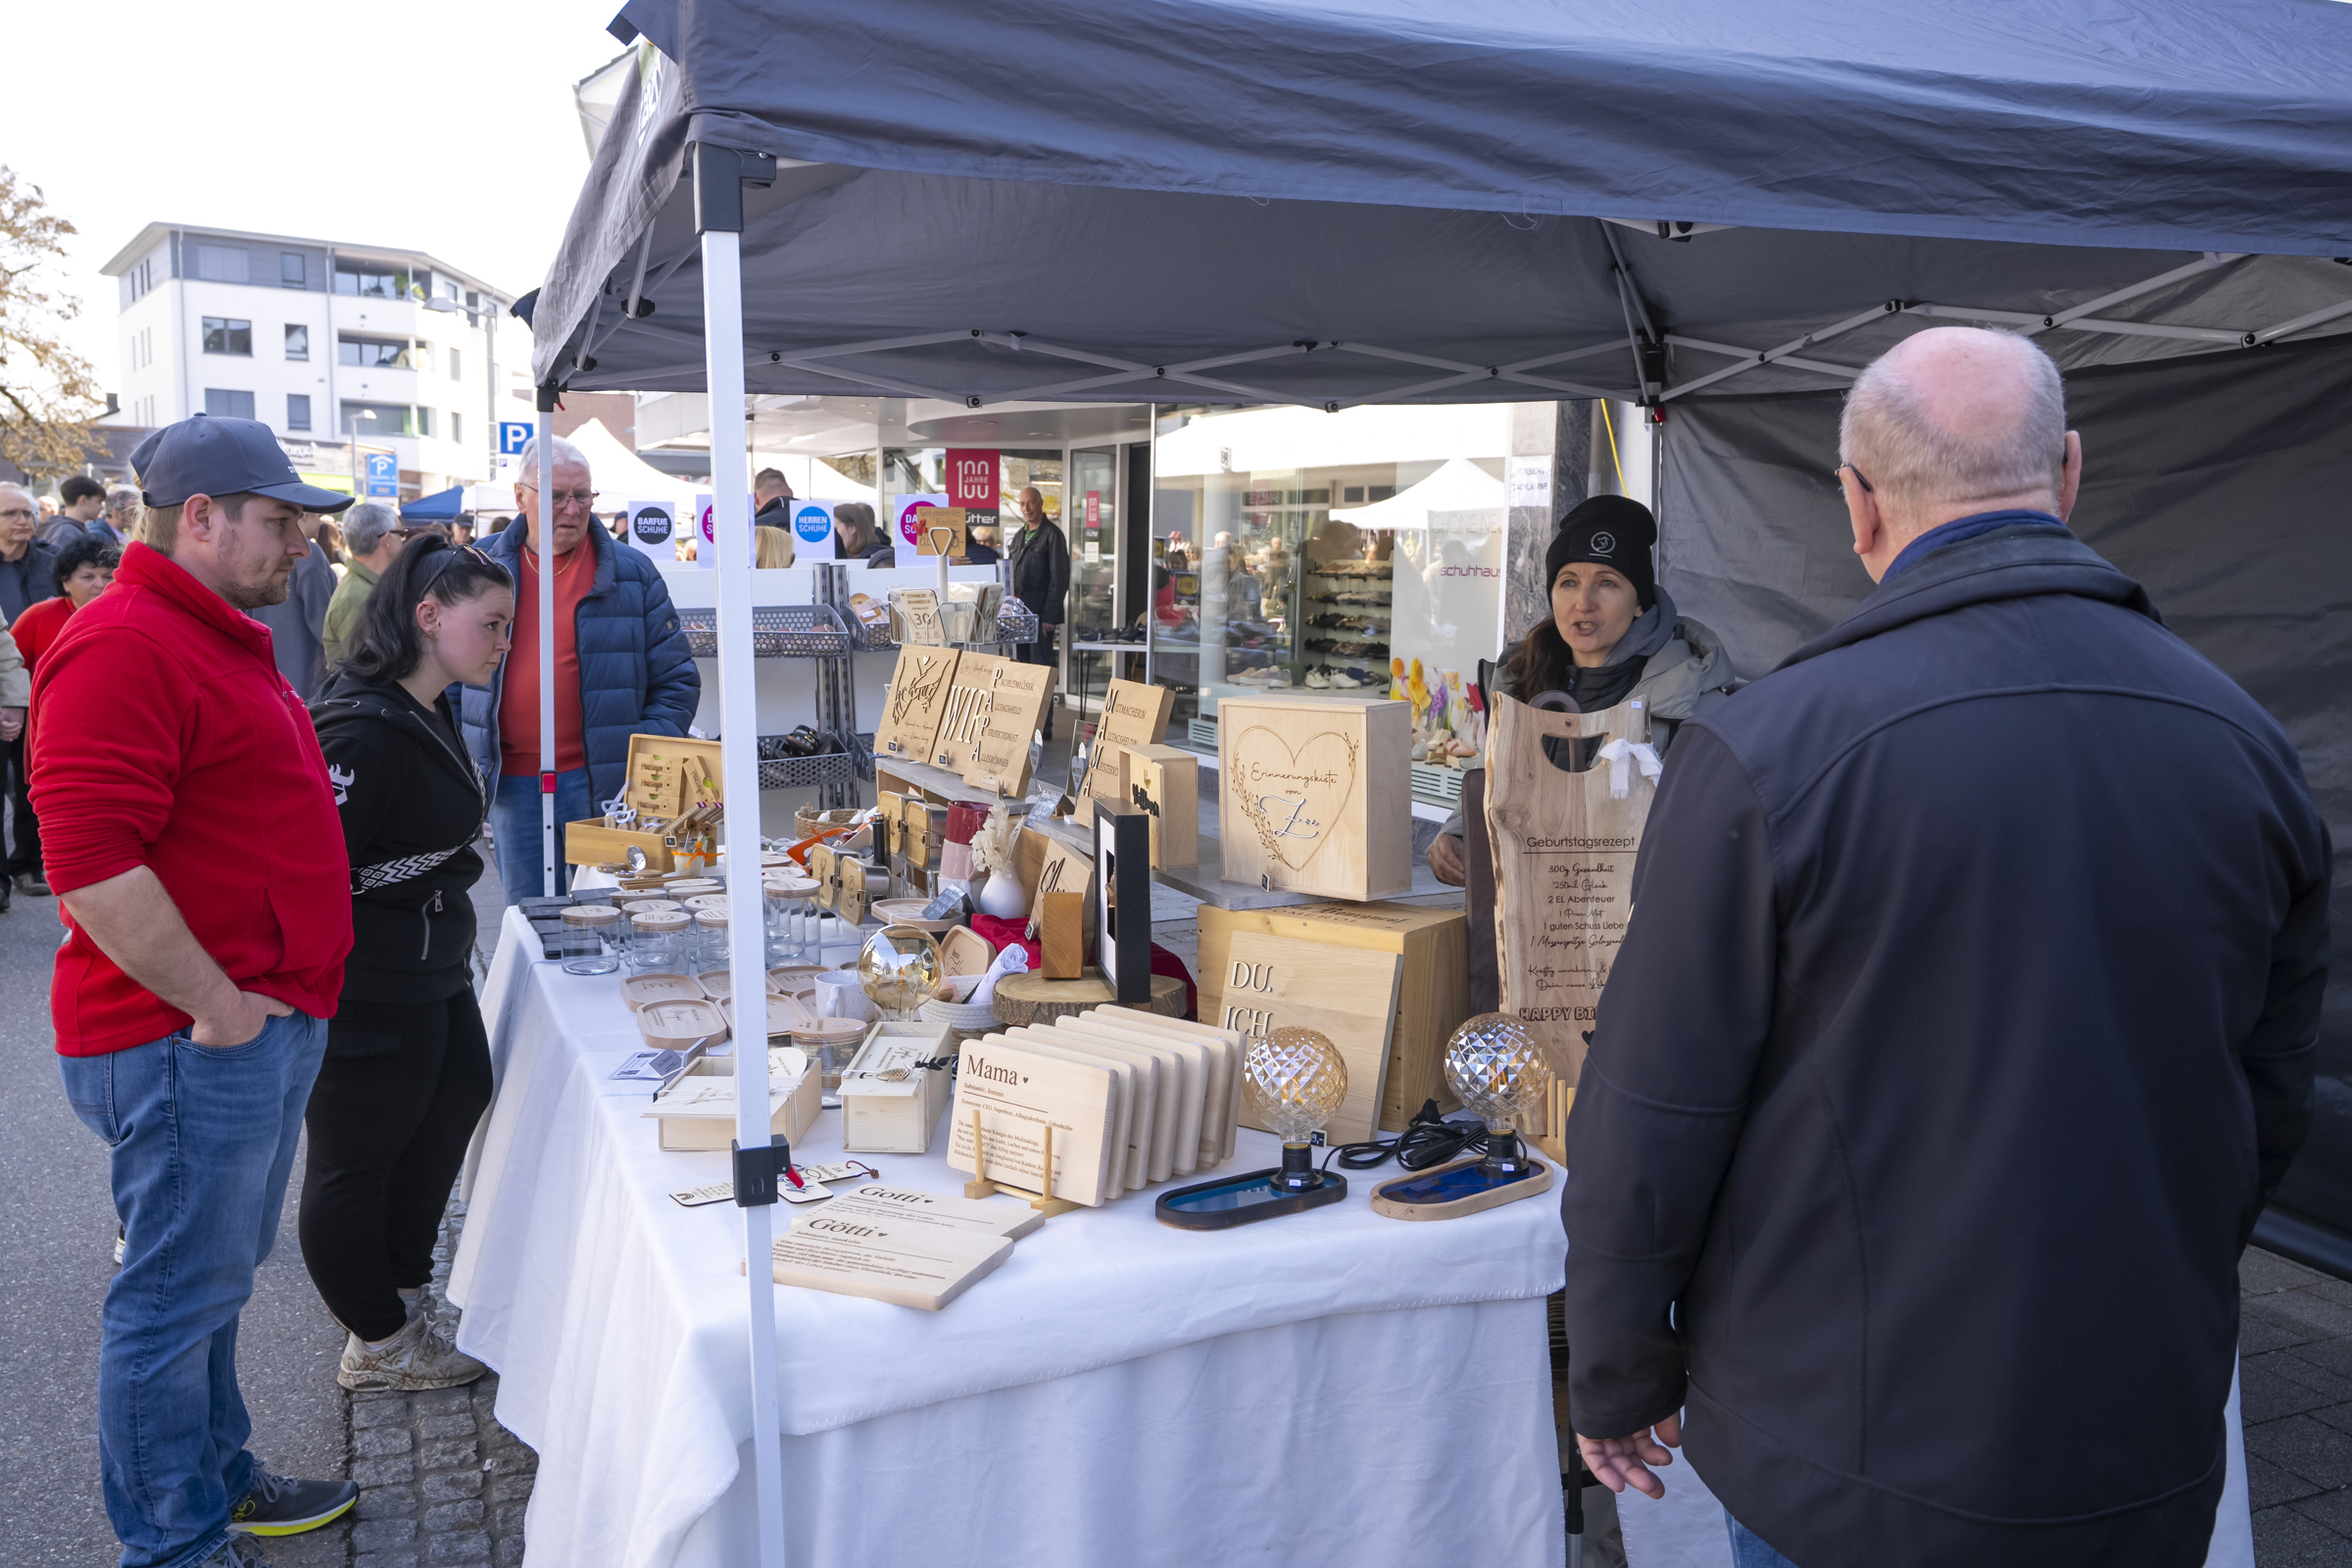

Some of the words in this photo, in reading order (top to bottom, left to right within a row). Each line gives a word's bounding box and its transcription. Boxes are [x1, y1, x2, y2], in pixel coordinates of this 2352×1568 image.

[507, 424, 527, 452] P
[376, 461, 388, 475] P
[965, 512, 997, 524] ütter
[637, 525, 668, 534] SCHUHE
[1250, 761, 1339, 789] Erinnerungskiste
[1526, 836, 1636, 849] Geburtstagsrezept
[1548, 864, 1570, 877] 300g
[1572, 862, 1615, 877] Gesundheit
[1567, 895, 1615, 904] Abenteuer
[1273, 908, 1358, 924] OMEROL
[1549, 922, 1574, 933] guten
[1602, 921, 1625, 930] Liebe
[1229, 960, 1273, 993] DU.
[1599, 964, 1607, 974] &
[1535, 979, 1564, 992] Dein
[1519, 1007, 1572, 1021] HAPPY
[1574, 1006, 1597, 1021] BI
[1224, 1005, 1273, 1039] ICH
[966, 1054, 1018, 1086] Mama
[858, 1187, 925, 1202] Gotti
[808, 1217, 879, 1237] Götti
